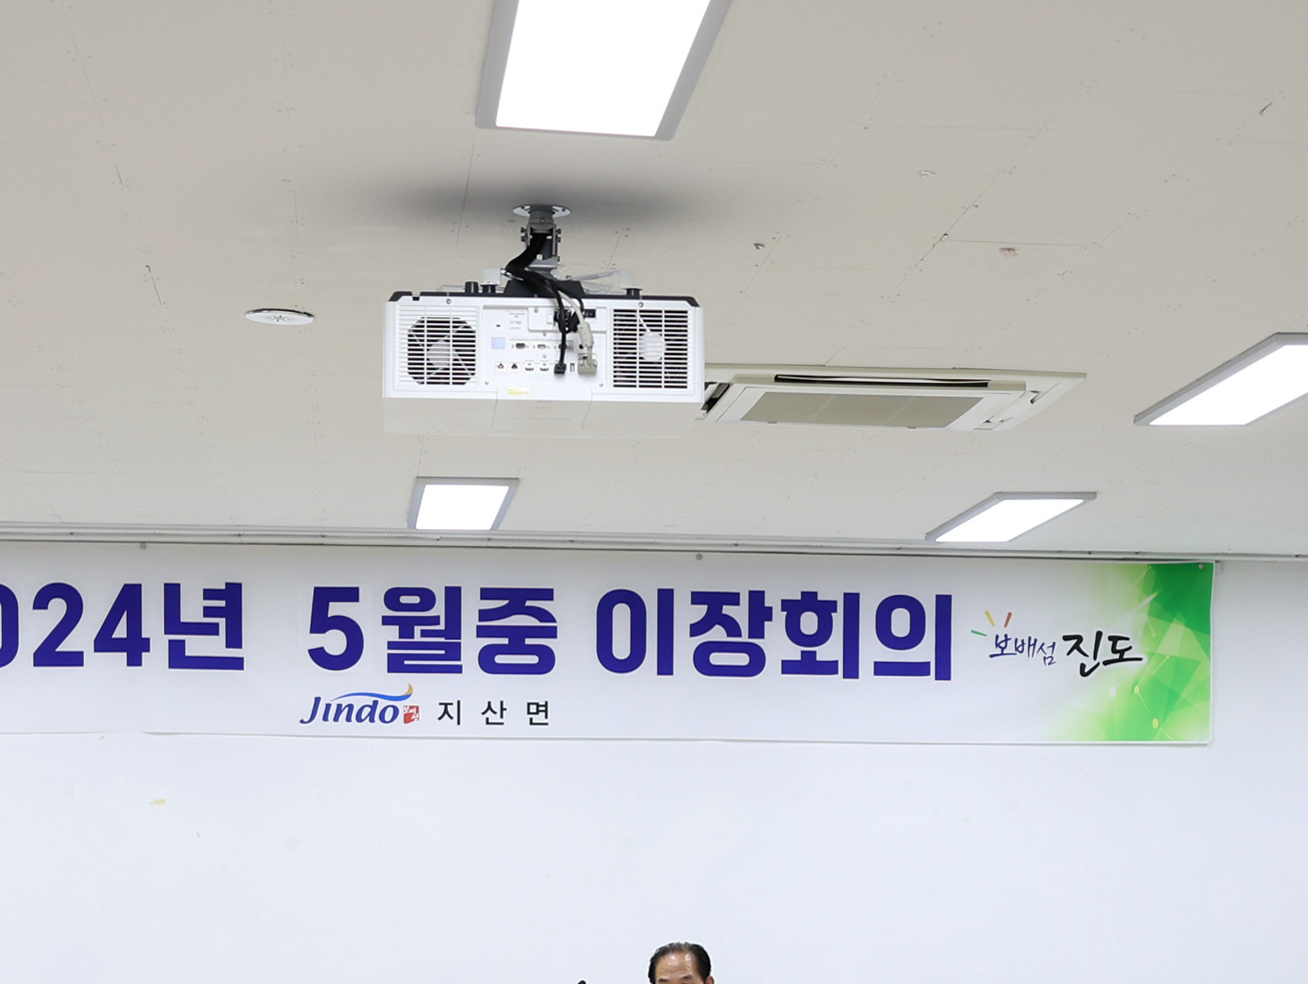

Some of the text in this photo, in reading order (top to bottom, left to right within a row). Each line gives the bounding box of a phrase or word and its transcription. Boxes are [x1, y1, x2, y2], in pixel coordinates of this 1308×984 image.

[307, 586, 559, 676] 5월중
[596, 588, 954, 682] 이장회의
[989, 630, 1143, 678] 보배섬 진도
[299, 696, 400, 724] Jindo
